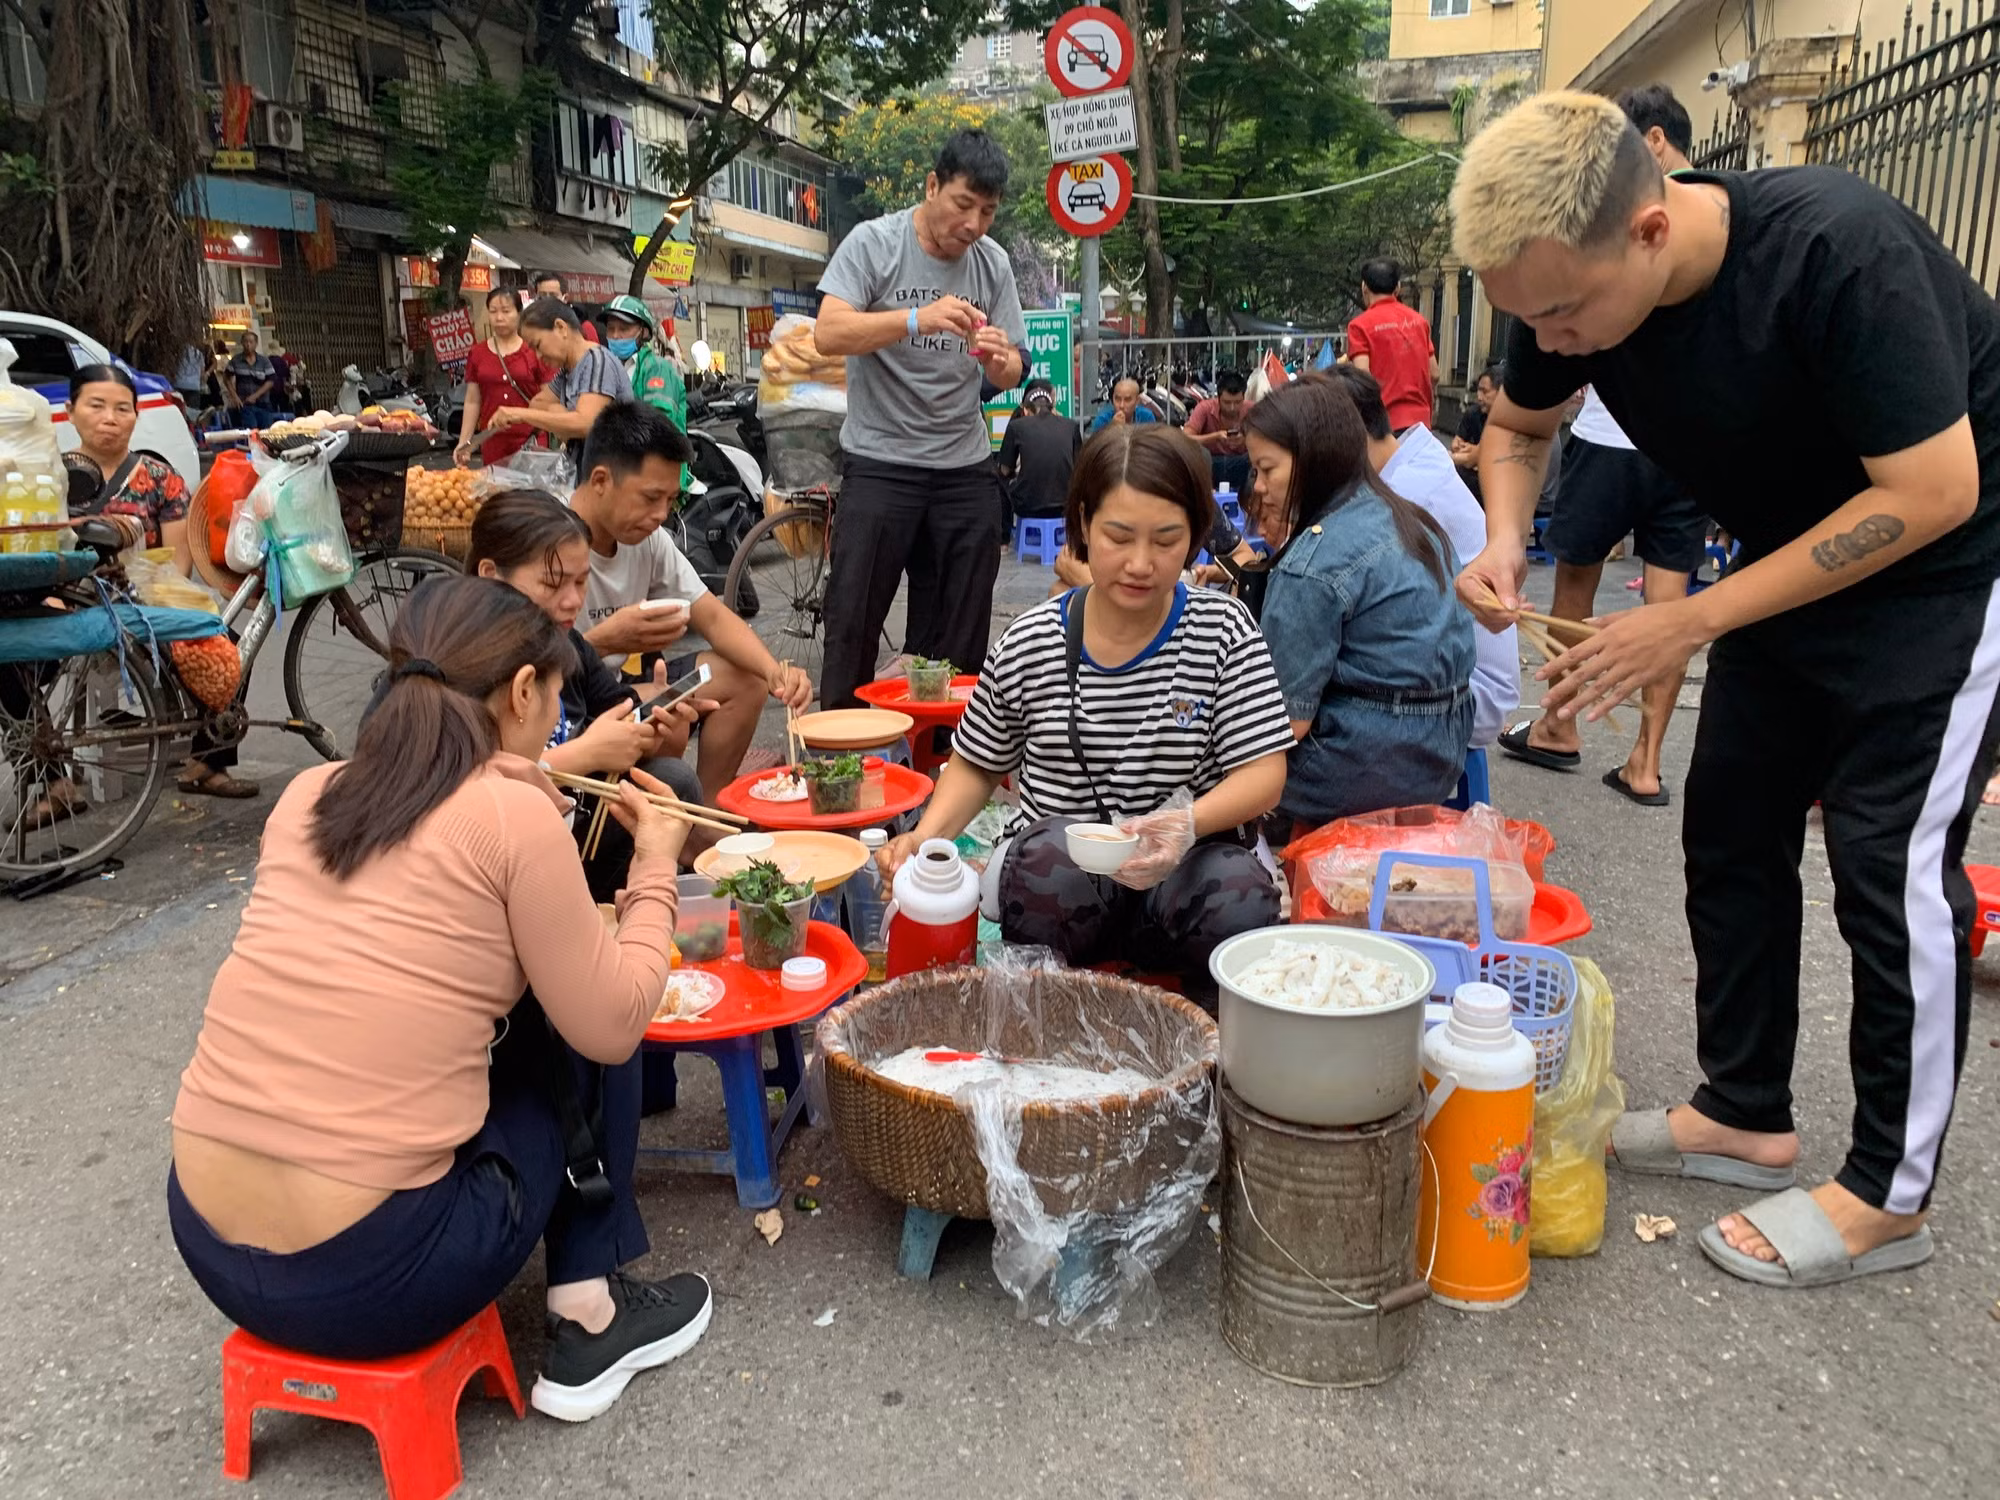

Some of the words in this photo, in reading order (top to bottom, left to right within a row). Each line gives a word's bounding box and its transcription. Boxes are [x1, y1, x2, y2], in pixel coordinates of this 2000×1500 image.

[1050, 108, 1061, 120] XE
[1064, 122, 1075, 136] 09
[1071, 162, 1104, 179] TAXI
[470, 267, 489, 286] 35K
[895, 287, 942, 302] BATS
[430, 308, 465, 326] CƠM
[435, 331, 474, 353] CHÁO
[911, 336, 952, 352] LIKE
